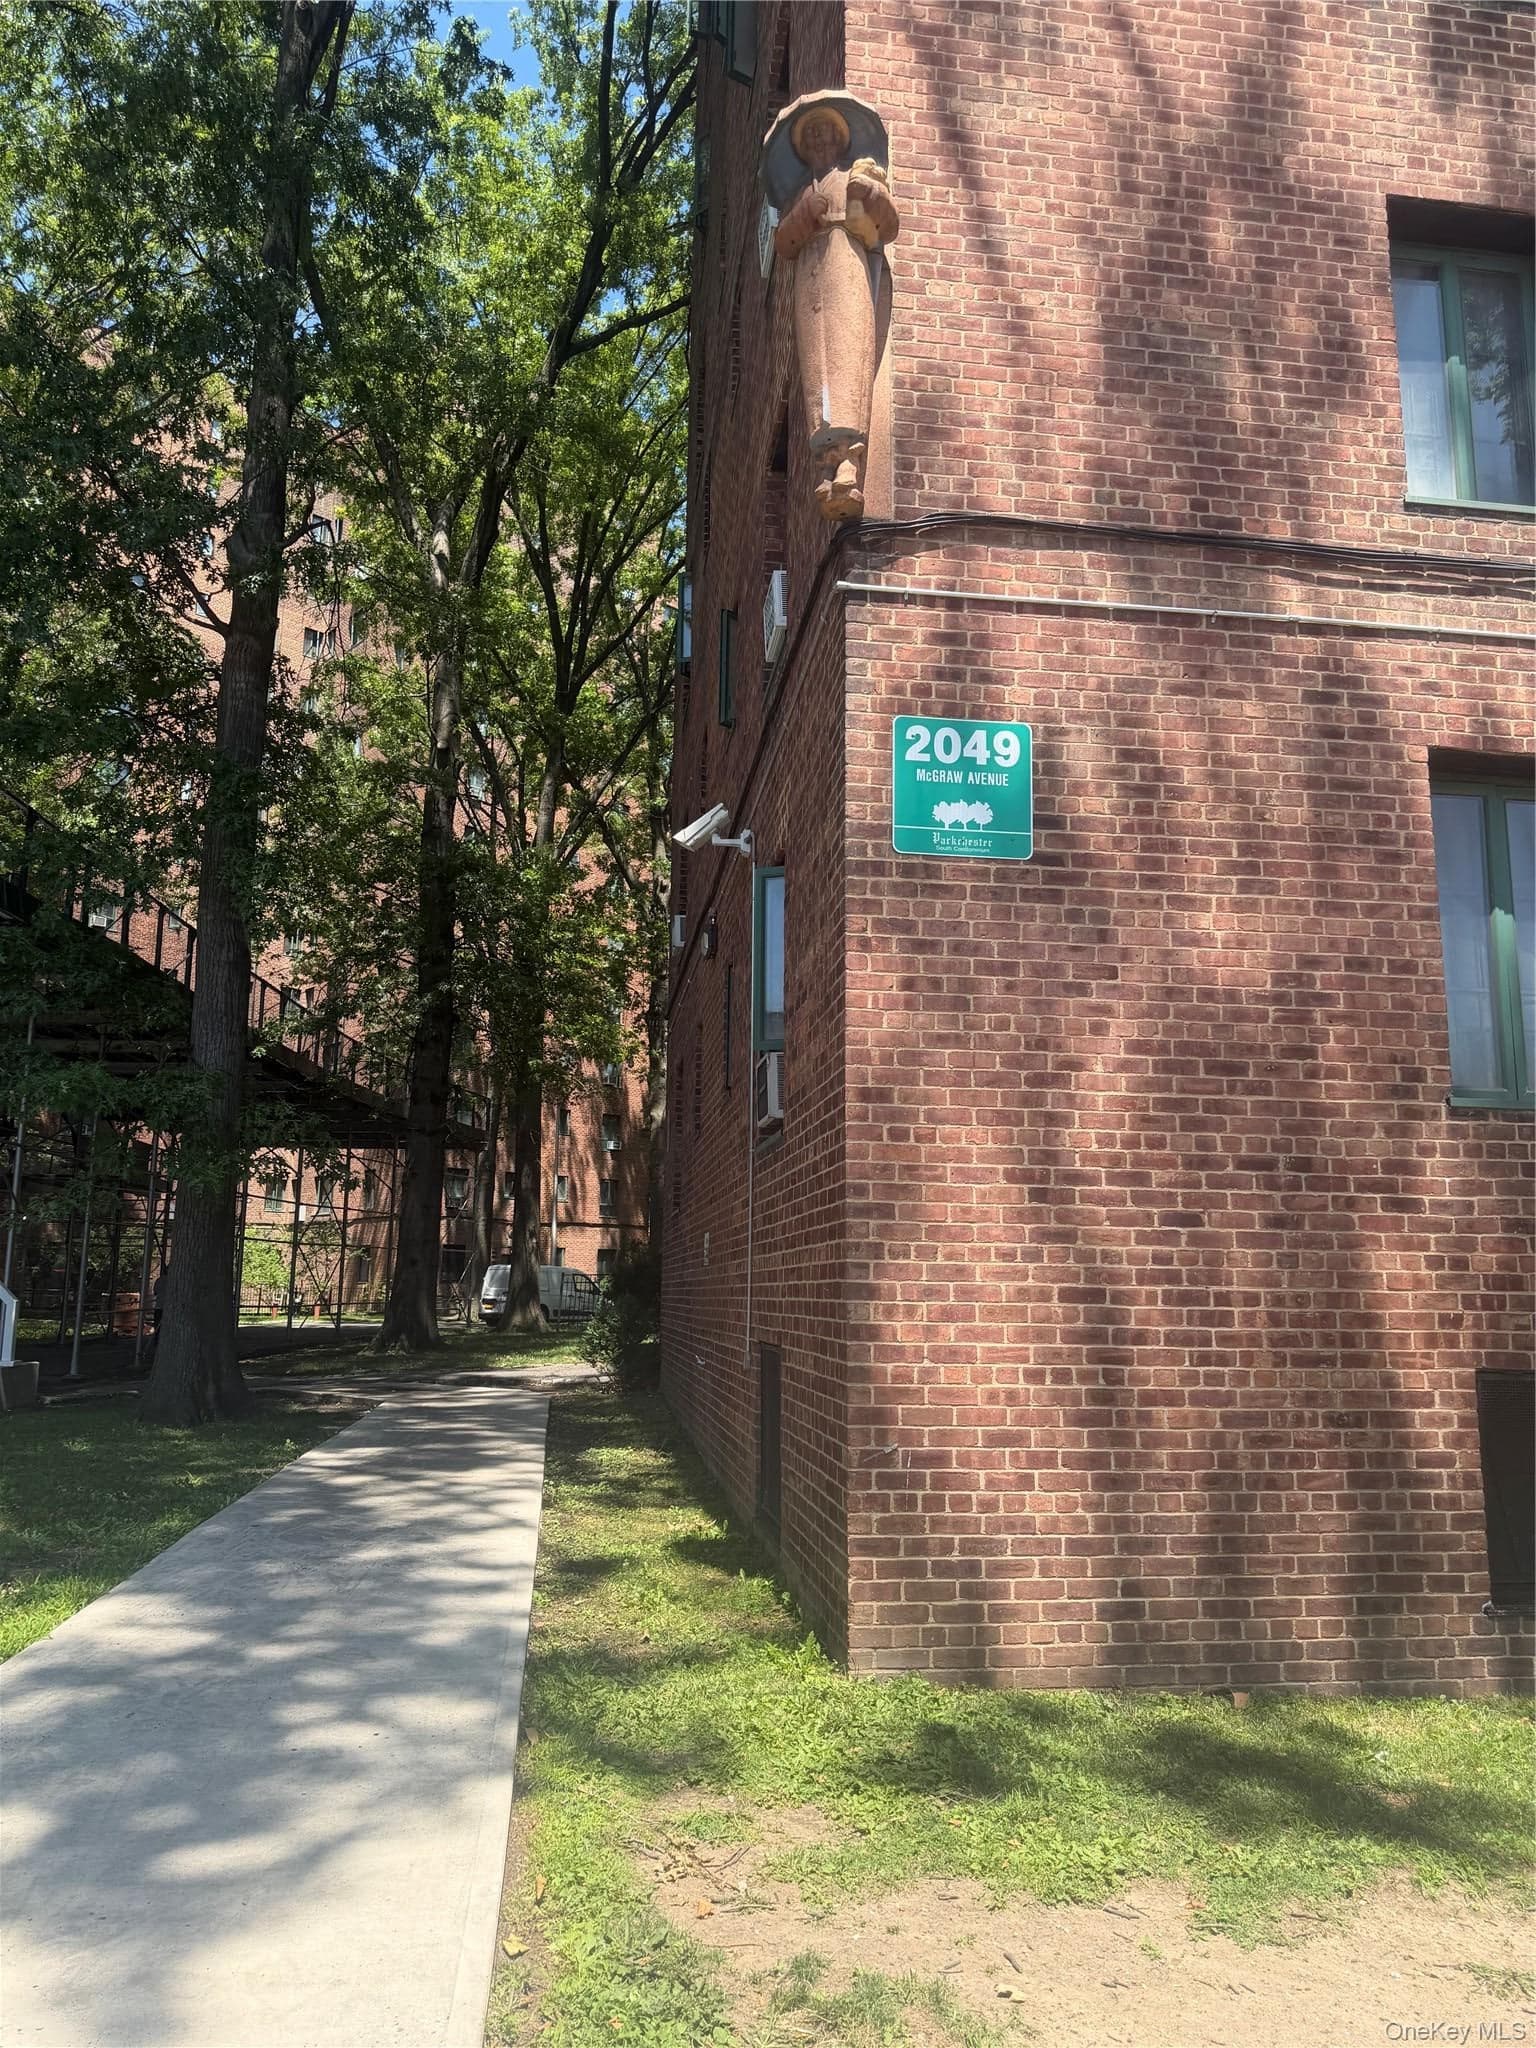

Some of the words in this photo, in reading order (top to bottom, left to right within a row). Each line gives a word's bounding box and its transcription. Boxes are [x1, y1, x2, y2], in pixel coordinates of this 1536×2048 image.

[905, 725, 1020, 767] 2049
[916, 769, 963, 784] McGRAW
[967, 772, 1009, 787] AVENUE
